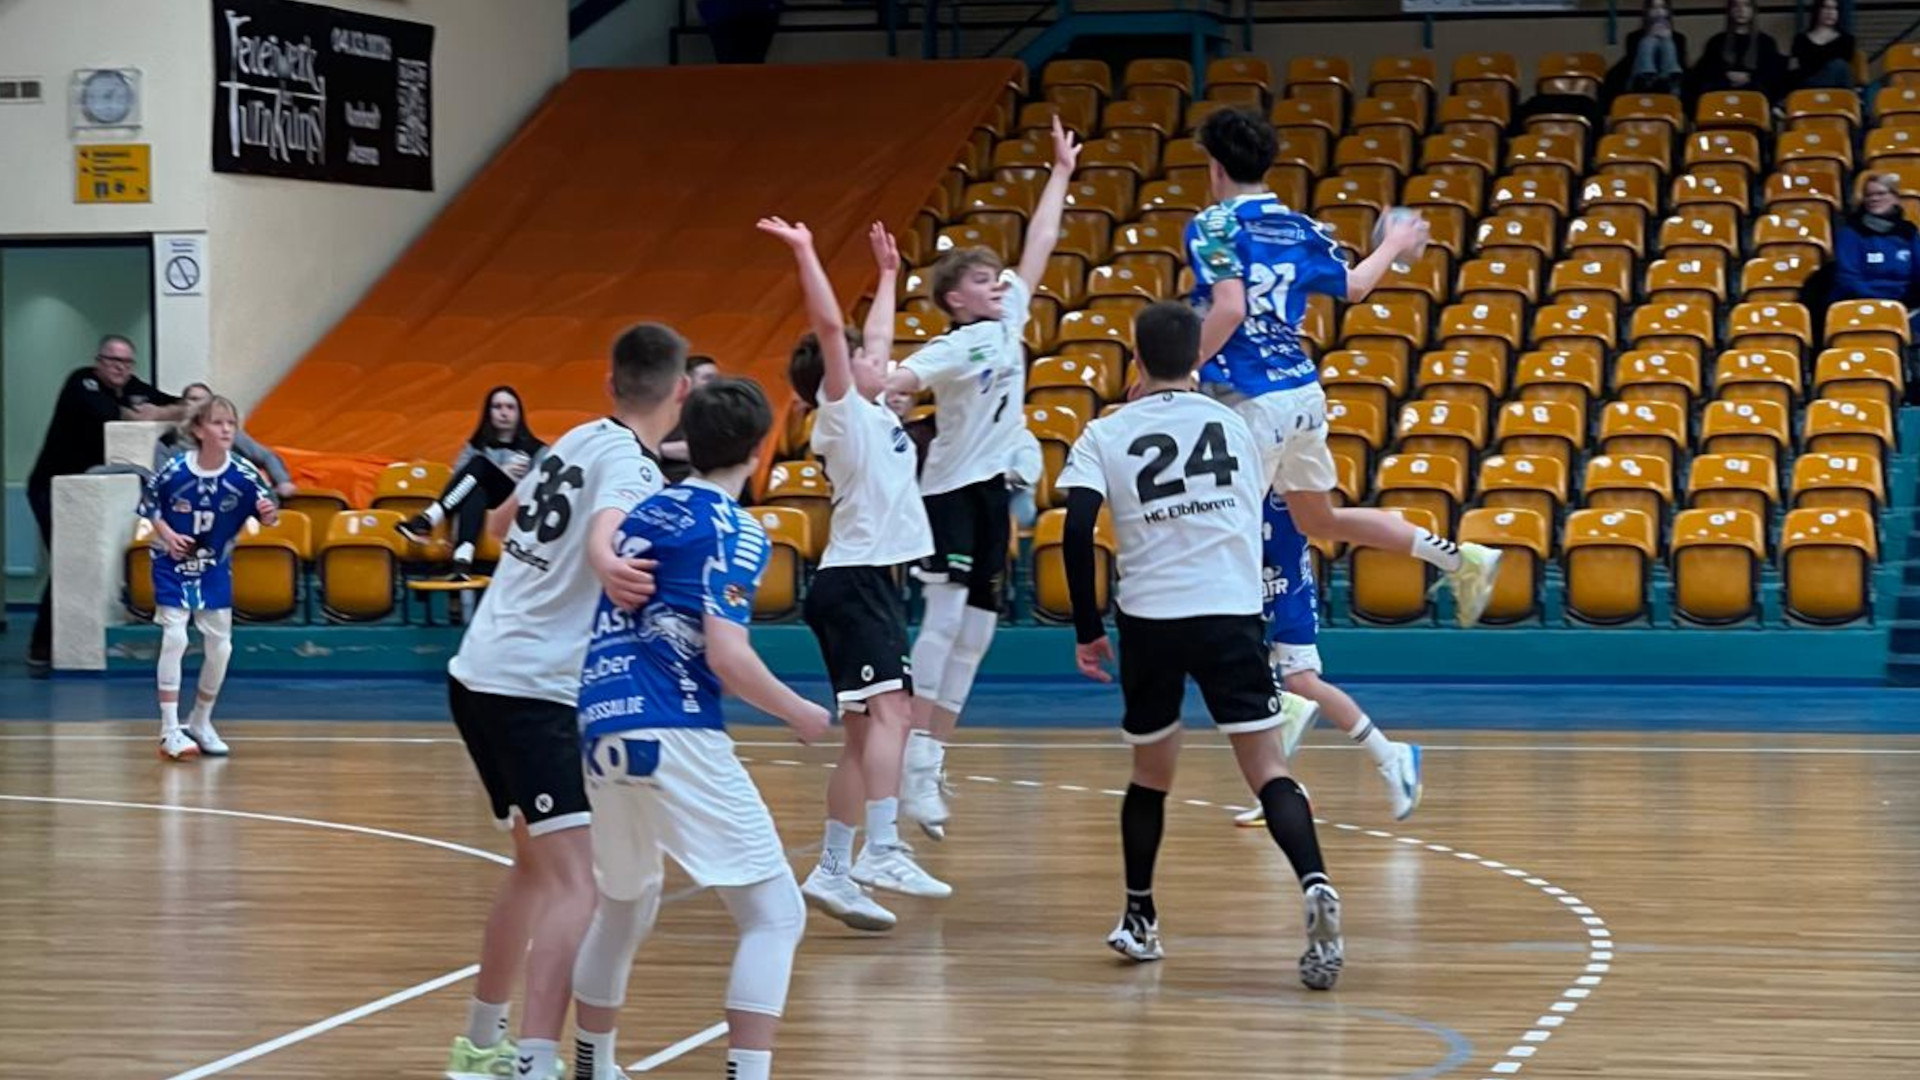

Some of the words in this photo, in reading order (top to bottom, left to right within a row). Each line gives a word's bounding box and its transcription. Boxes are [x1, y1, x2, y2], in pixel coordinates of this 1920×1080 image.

[1248, 262, 1296, 323] 27
[1127, 421, 1240, 504] 24
[193, 510, 215, 535] 13
[516, 454, 584, 544] 36
[1144, 508, 1167, 524] HC
